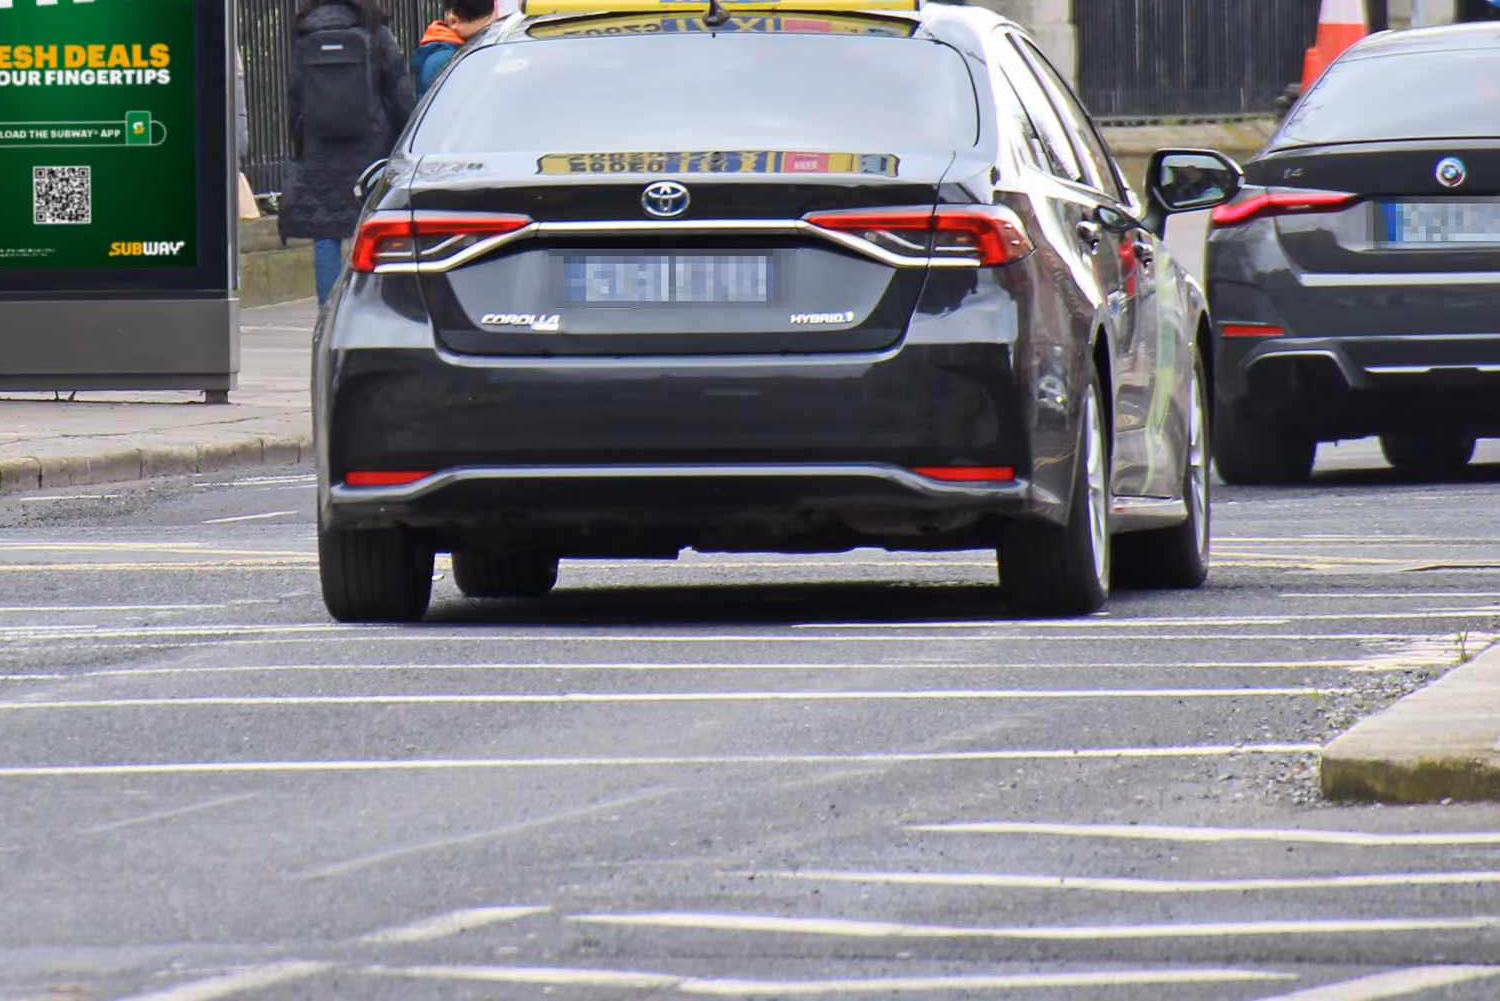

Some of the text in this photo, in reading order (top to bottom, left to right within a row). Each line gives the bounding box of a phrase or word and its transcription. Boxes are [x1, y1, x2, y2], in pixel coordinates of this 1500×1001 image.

[64, 43, 170, 68] DEALS
[44, 69, 171, 86] FINGERTIPS
[29, 130, 49, 139] THE
[100, 129, 121, 138] APP
[108, 241, 185, 256] SUBWAY
[481, 312, 560, 325] COROLLA
[790, 313, 844, 324] HYBRID
